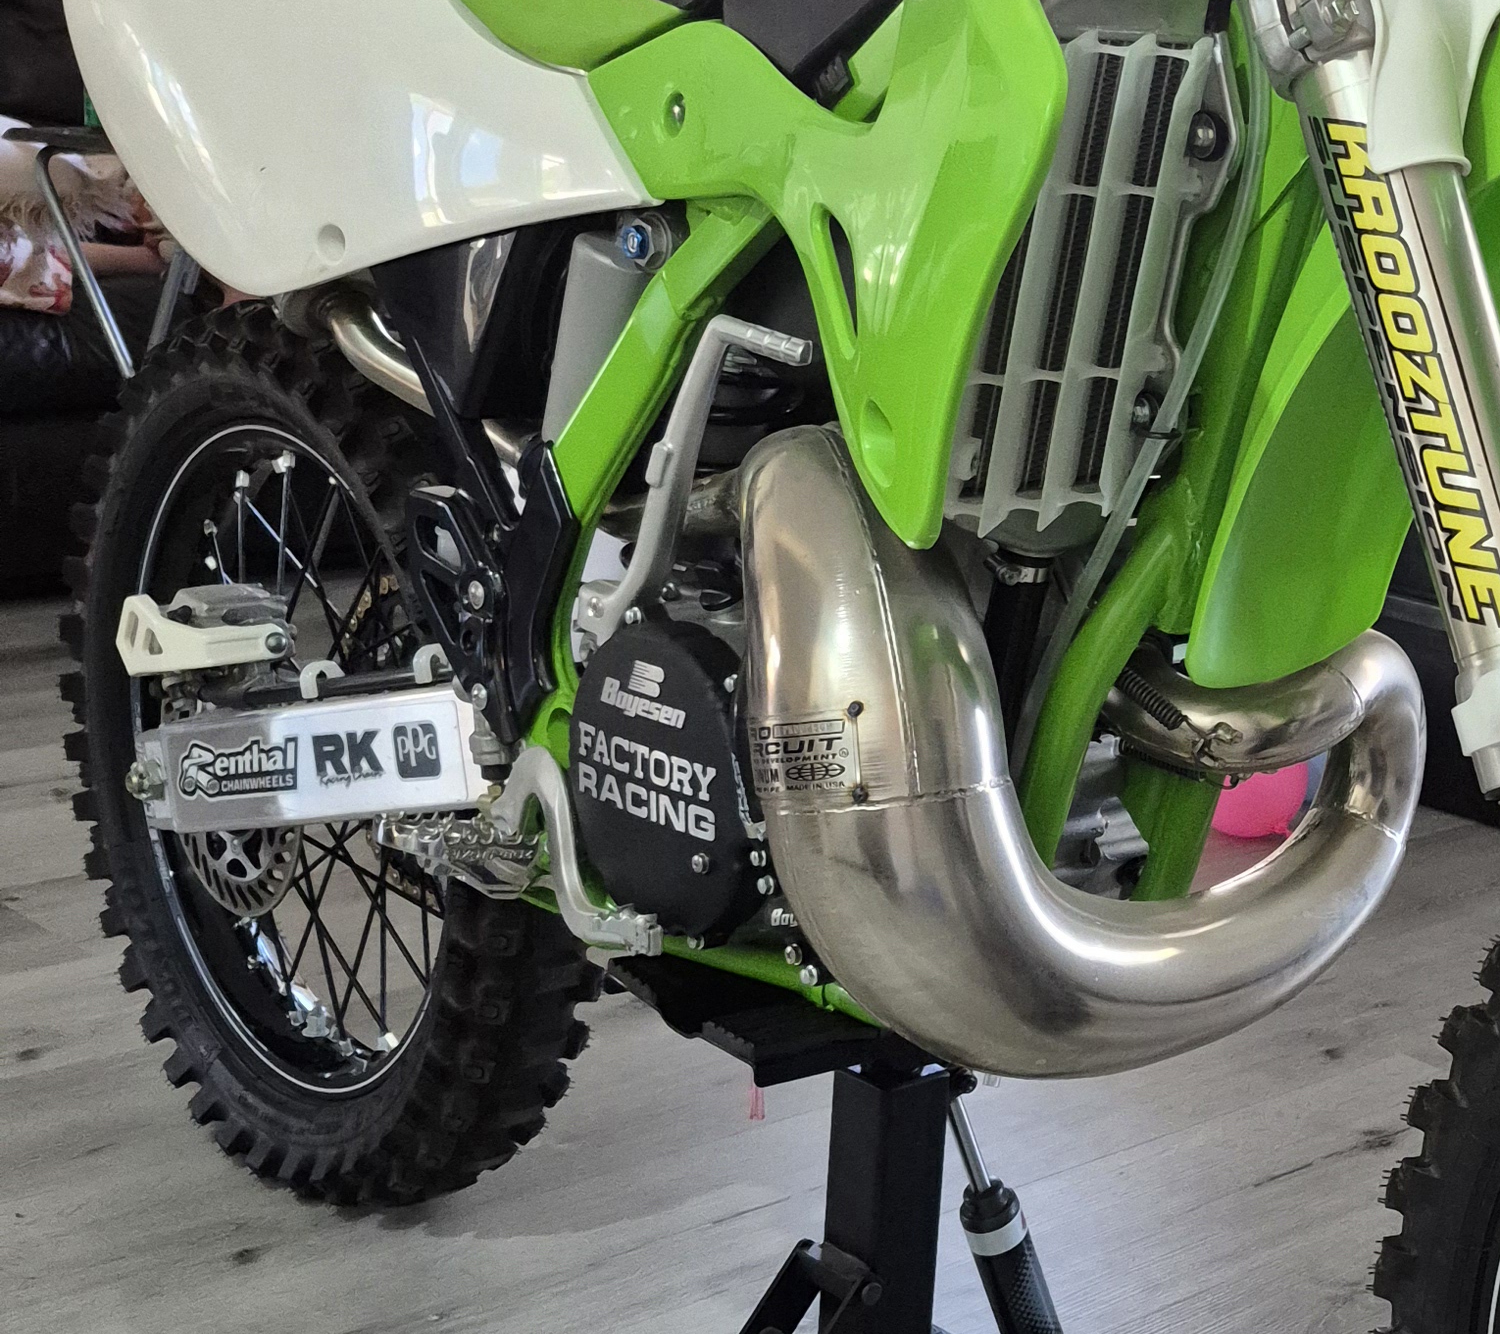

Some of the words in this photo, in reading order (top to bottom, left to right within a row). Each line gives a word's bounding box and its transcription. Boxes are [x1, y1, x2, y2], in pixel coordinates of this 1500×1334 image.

[1308, 115, 1463, 622] SUSPENSION
[601, 676, 686, 730] Boyesen
[181, 740, 297, 795] Renthal
[311, 730, 384, 776] RK
[577, 721, 716, 801] FACTORY
[221, 774, 295, 793] CHAINWHEELS
[578, 762, 716, 842] RACING
